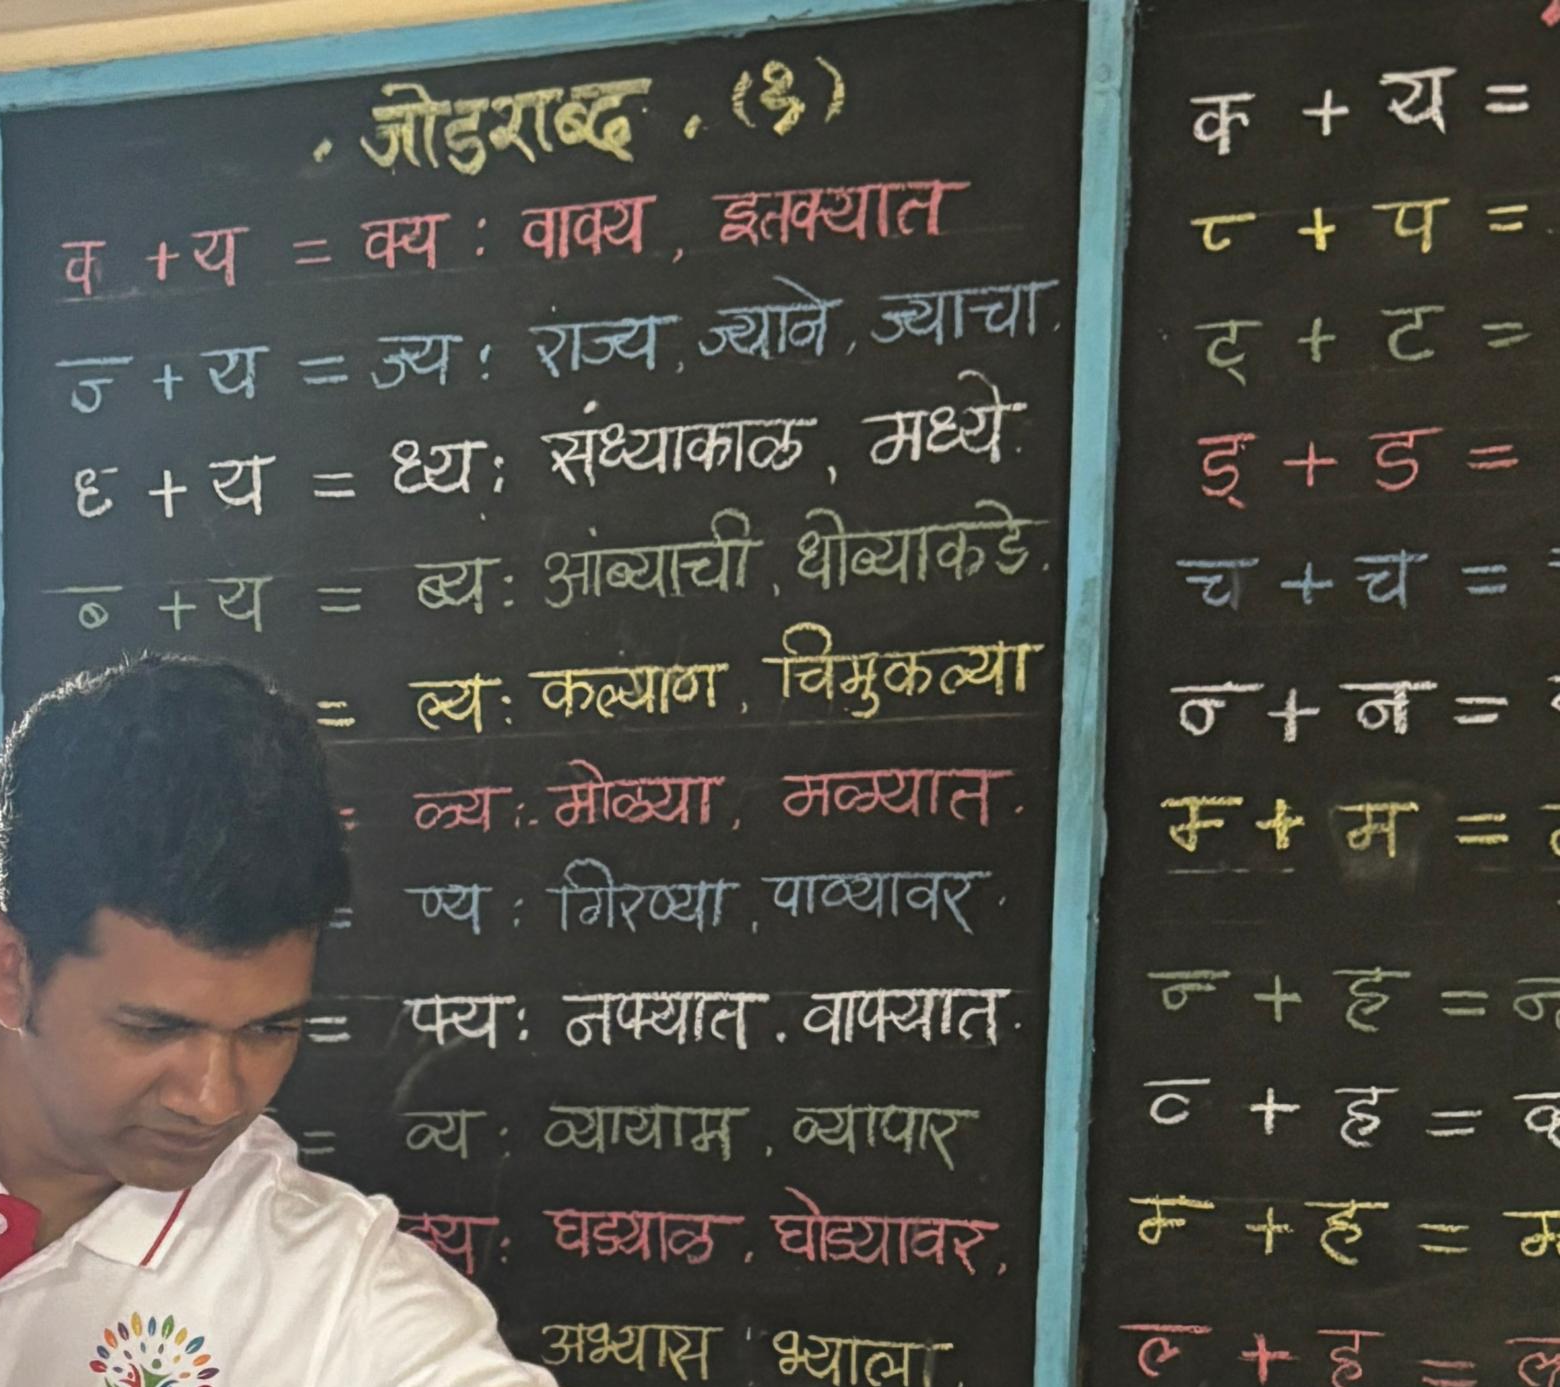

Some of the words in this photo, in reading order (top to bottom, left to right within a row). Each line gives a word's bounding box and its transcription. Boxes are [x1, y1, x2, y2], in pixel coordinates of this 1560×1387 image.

[1302, 89, 1350, 136] +
[1485, 84, 1530, 114] =
[1297, 206, 1336, 252] +
[1486, 204, 1528, 232] =
[146, 242, 180, 280] +
[192, 227, 250, 287] य
[293, 239, 331, 264] =
[1297, 317, 1336, 363] +
[1482, 322, 1531, 348] =
[153, 364, 183, 400] +
[200, 346, 270, 399] य
[298, 355, 348, 384] =
[148, 470, 187, 518] +
[208, 454, 276, 516] य
[313, 472, 356, 498] =
[1283, 441, 1338, 487] +
[1467, 445, 1519, 469] =
[158, 591, 196, 630] +
[207, 576, 273, 632] य
[317, 587, 362, 612] =
[1280, 562, 1334, 605] +
[1461, 564, 1508, 595] =
[1267, 688, 1320, 743] +
[1453, 696, 1509, 724] =
[1255, 798, 1305, 850] +
[1455, 813, 1509, 845] =
[1254, 975, 1302, 1022] +
[1441, 990, 1489, 1016] =
[1248, 1087, 1301, 1135] +
[1425, 1109, 1483, 1137] =
[1245, 1207, 1294, 1255] +
[1417, 1223, 1470, 1254] =
[1238, 1333, 1298, 1385] +
